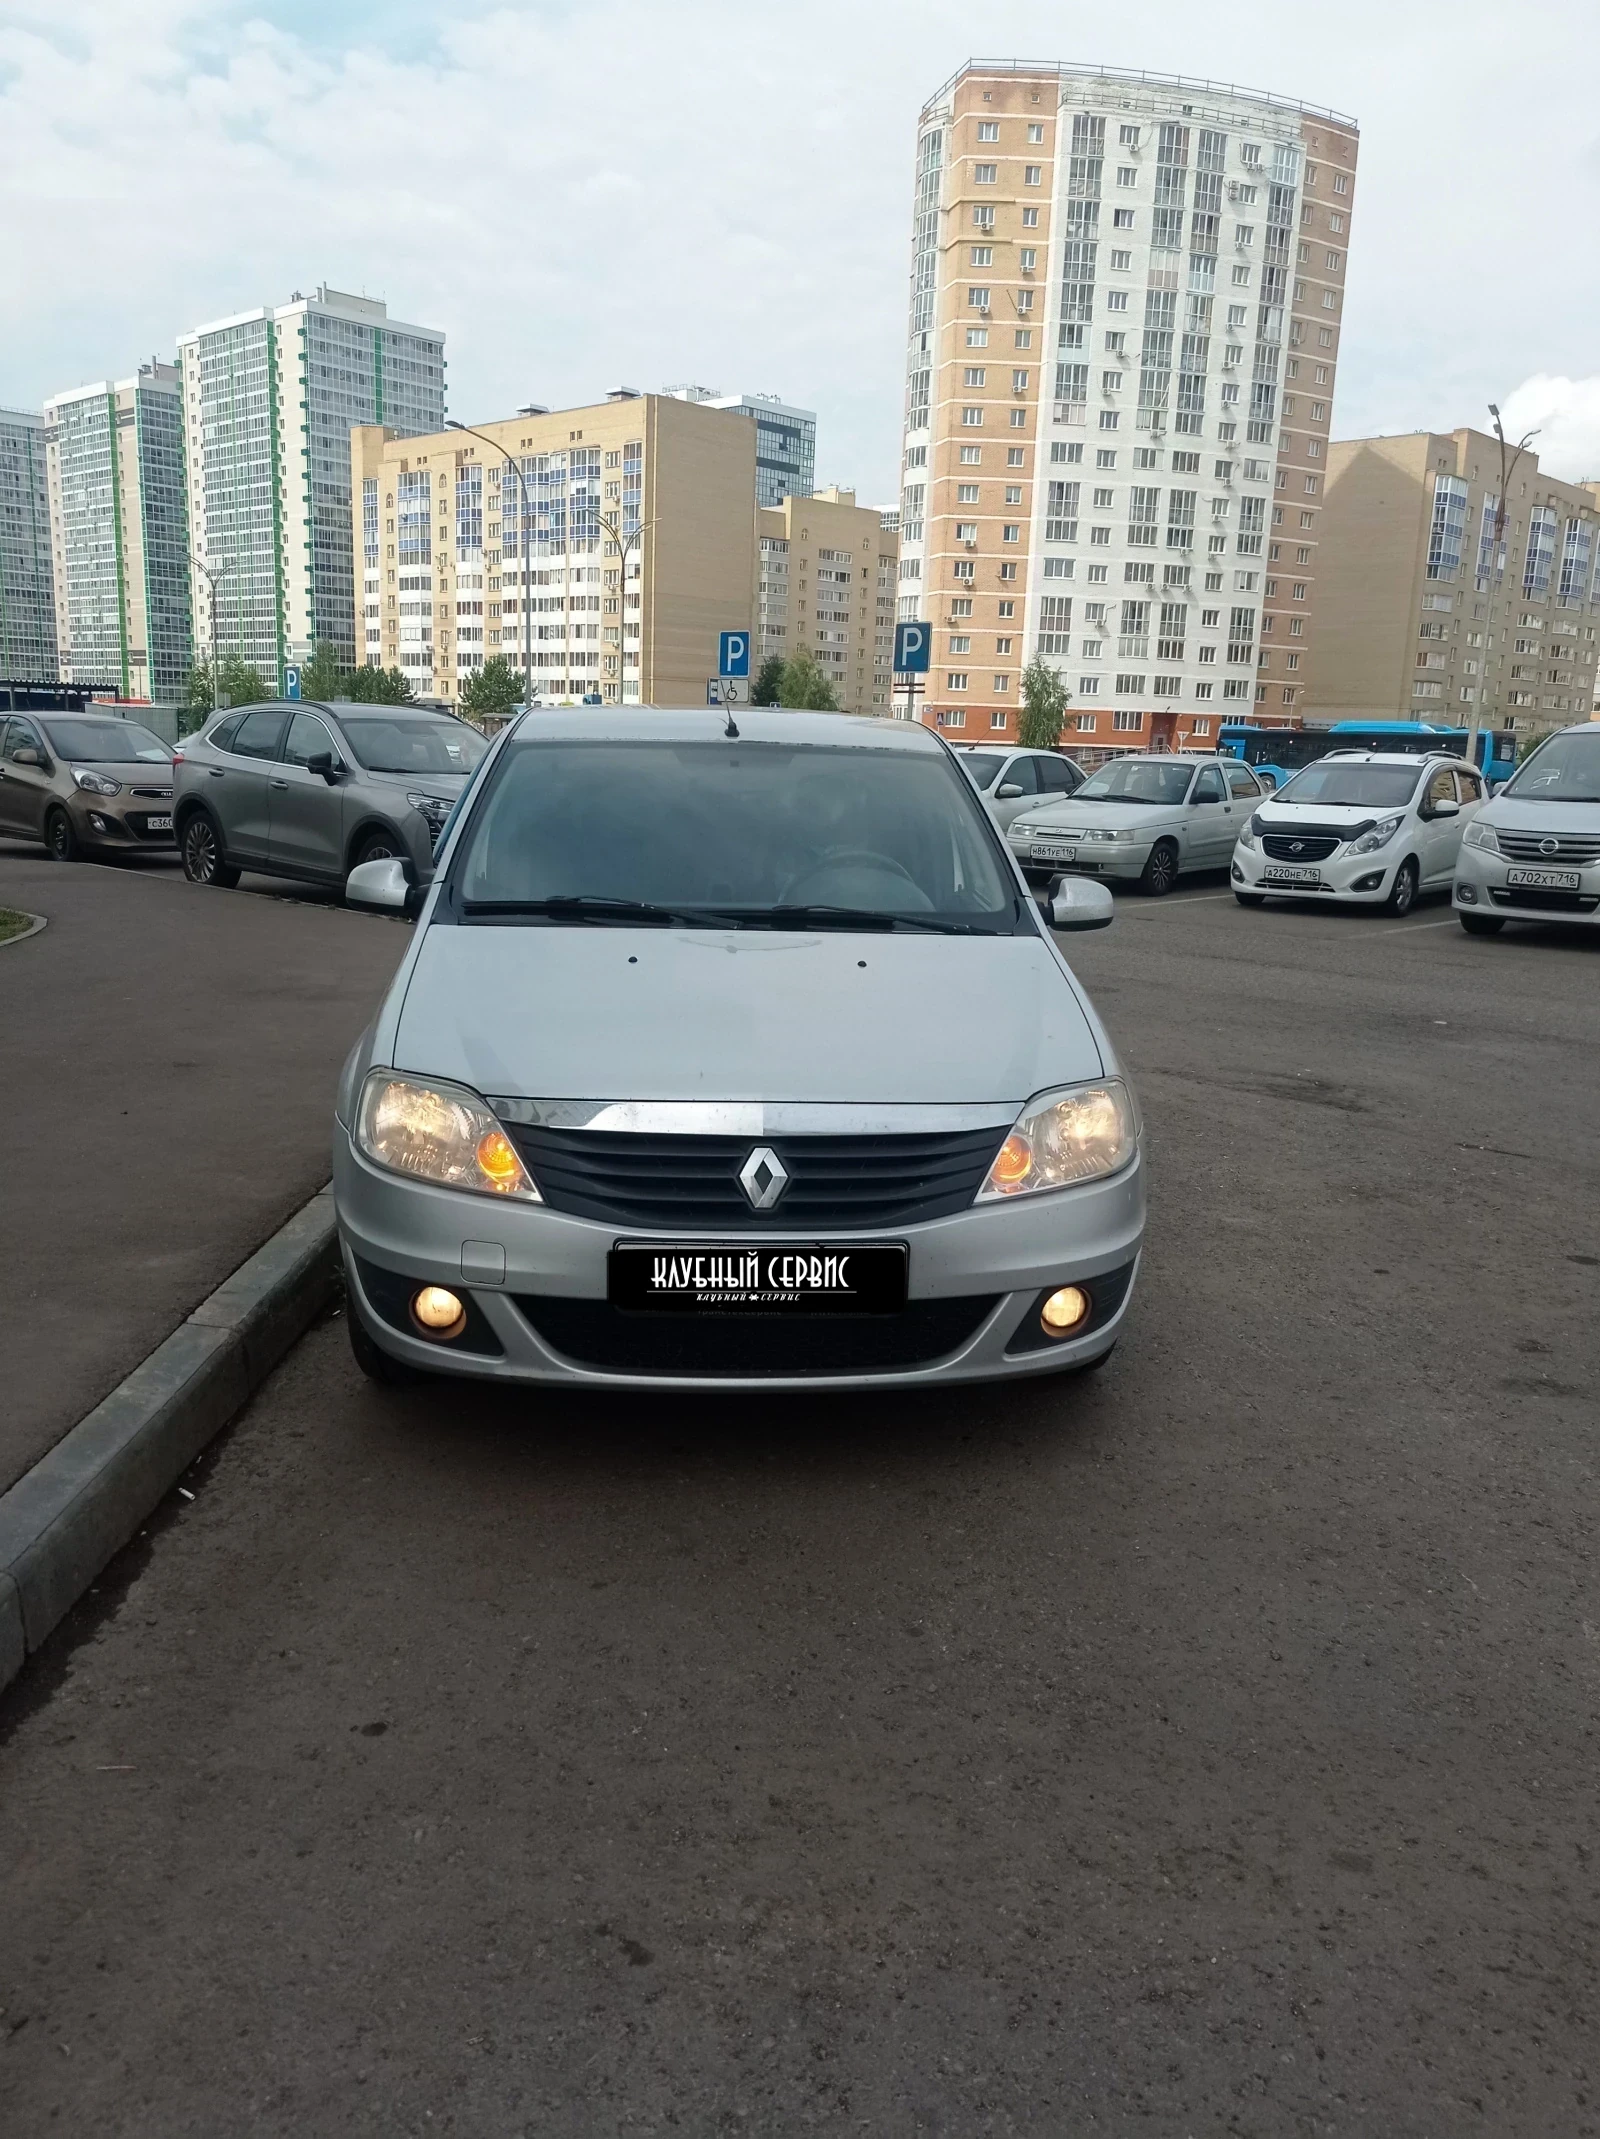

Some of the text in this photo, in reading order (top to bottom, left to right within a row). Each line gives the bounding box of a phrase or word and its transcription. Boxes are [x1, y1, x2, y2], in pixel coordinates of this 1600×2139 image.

[727, 636, 745, 672] P
[902, 627, 923, 666] P
[287, 670, 297, 696] P
